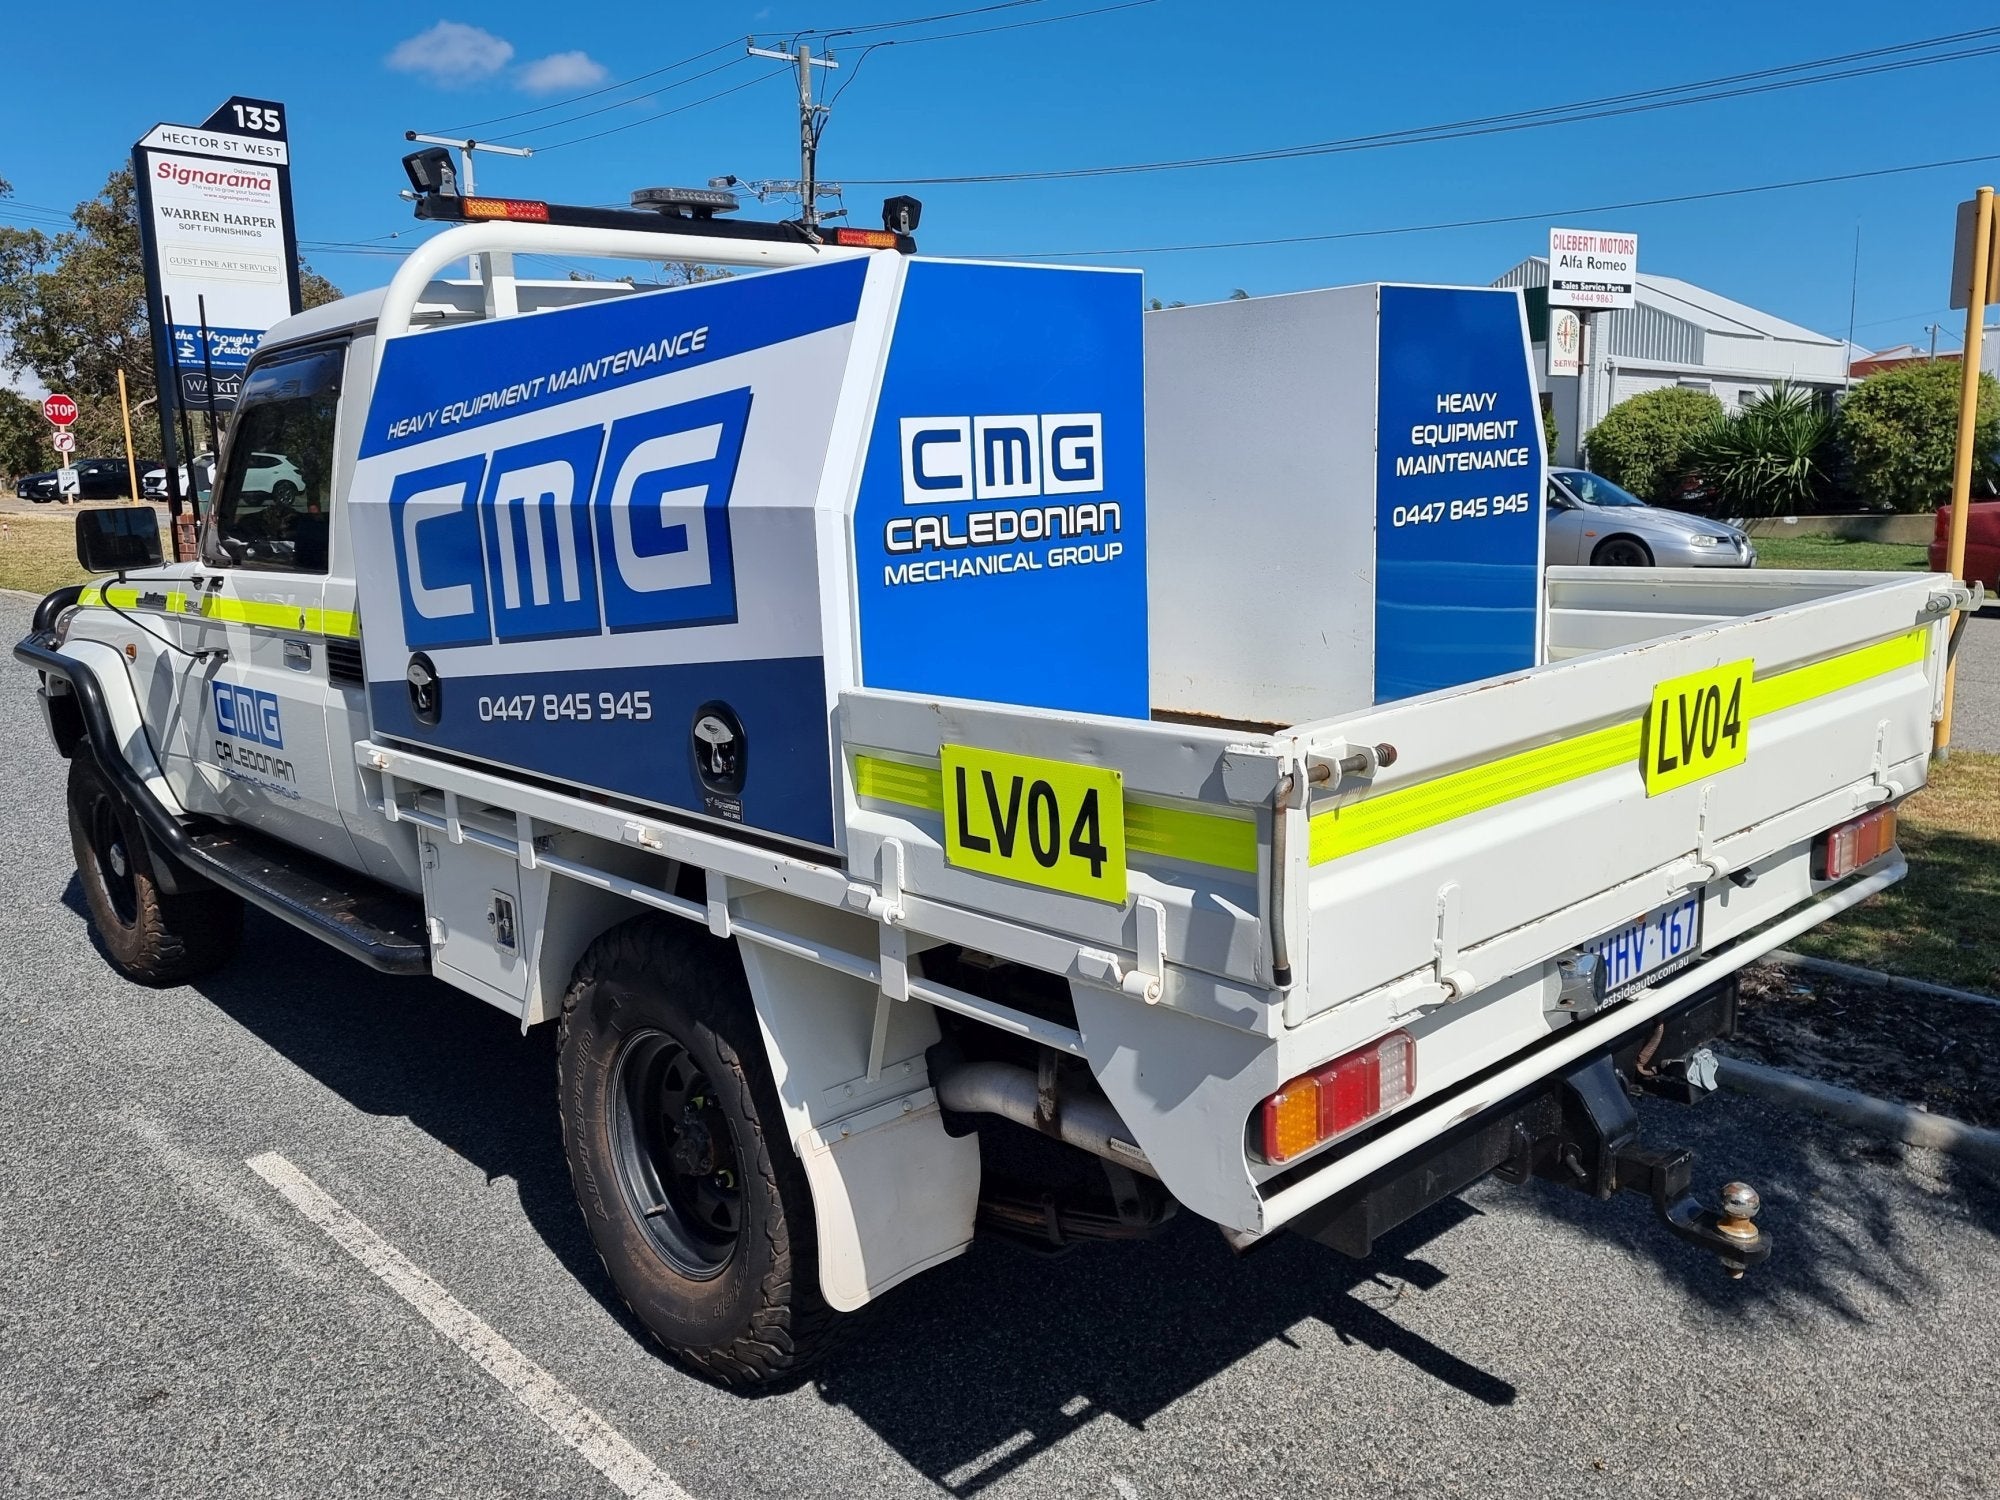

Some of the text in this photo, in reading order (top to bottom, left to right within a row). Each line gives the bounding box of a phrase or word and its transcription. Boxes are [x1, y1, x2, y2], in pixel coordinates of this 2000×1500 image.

[232, 104, 281, 133] 135
[162, 132, 281, 158] HECTOR ST WEST
[157, 162, 272, 191] Signarama
[160, 206, 277, 229] WARREN HARPER
[178, 222, 262, 238] SOFT FURNISHINGS
[1553, 234, 1635, 256] CILEBERTI MOTORS
[169, 257, 278, 272] GUEST FINE ART SERVICES
[1559, 254, 1627, 272] Alfa Romeo
[1561, 280, 1625, 293] Sales Service Parts
[175, 329, 194, 340] the
[387, 326, 709, 441] HEAVY EQUIPMENT MAINTENANCE
[46, 403, 75, 417] STOP
[1437, 392, 1498, 414] HEAVY
[1411, 420, 1519, 448] EQUIPMENT
[911, 424, 1095, 490] CMG
[1396, 447, 1529, 477] MAINTENANCE
[402, 422, 724, 619] CMG
[1392, 492, 1529, 528] 0447 845 945
[885, 502, 1121, 554] CALEDONIAN
[884, 542, 1123, 587] MECHANICAL GROUP
[215, 689, 280, 742] CMG
[478, 690, 652, 723] 0447 845 945
[1657, 676, 1742, 775] LV04
[215, 739, 297, 785] CALEDONIAN
[956, 765, 1108, 879] LV04
[1590, 900, 1696, 989] HHV 167
